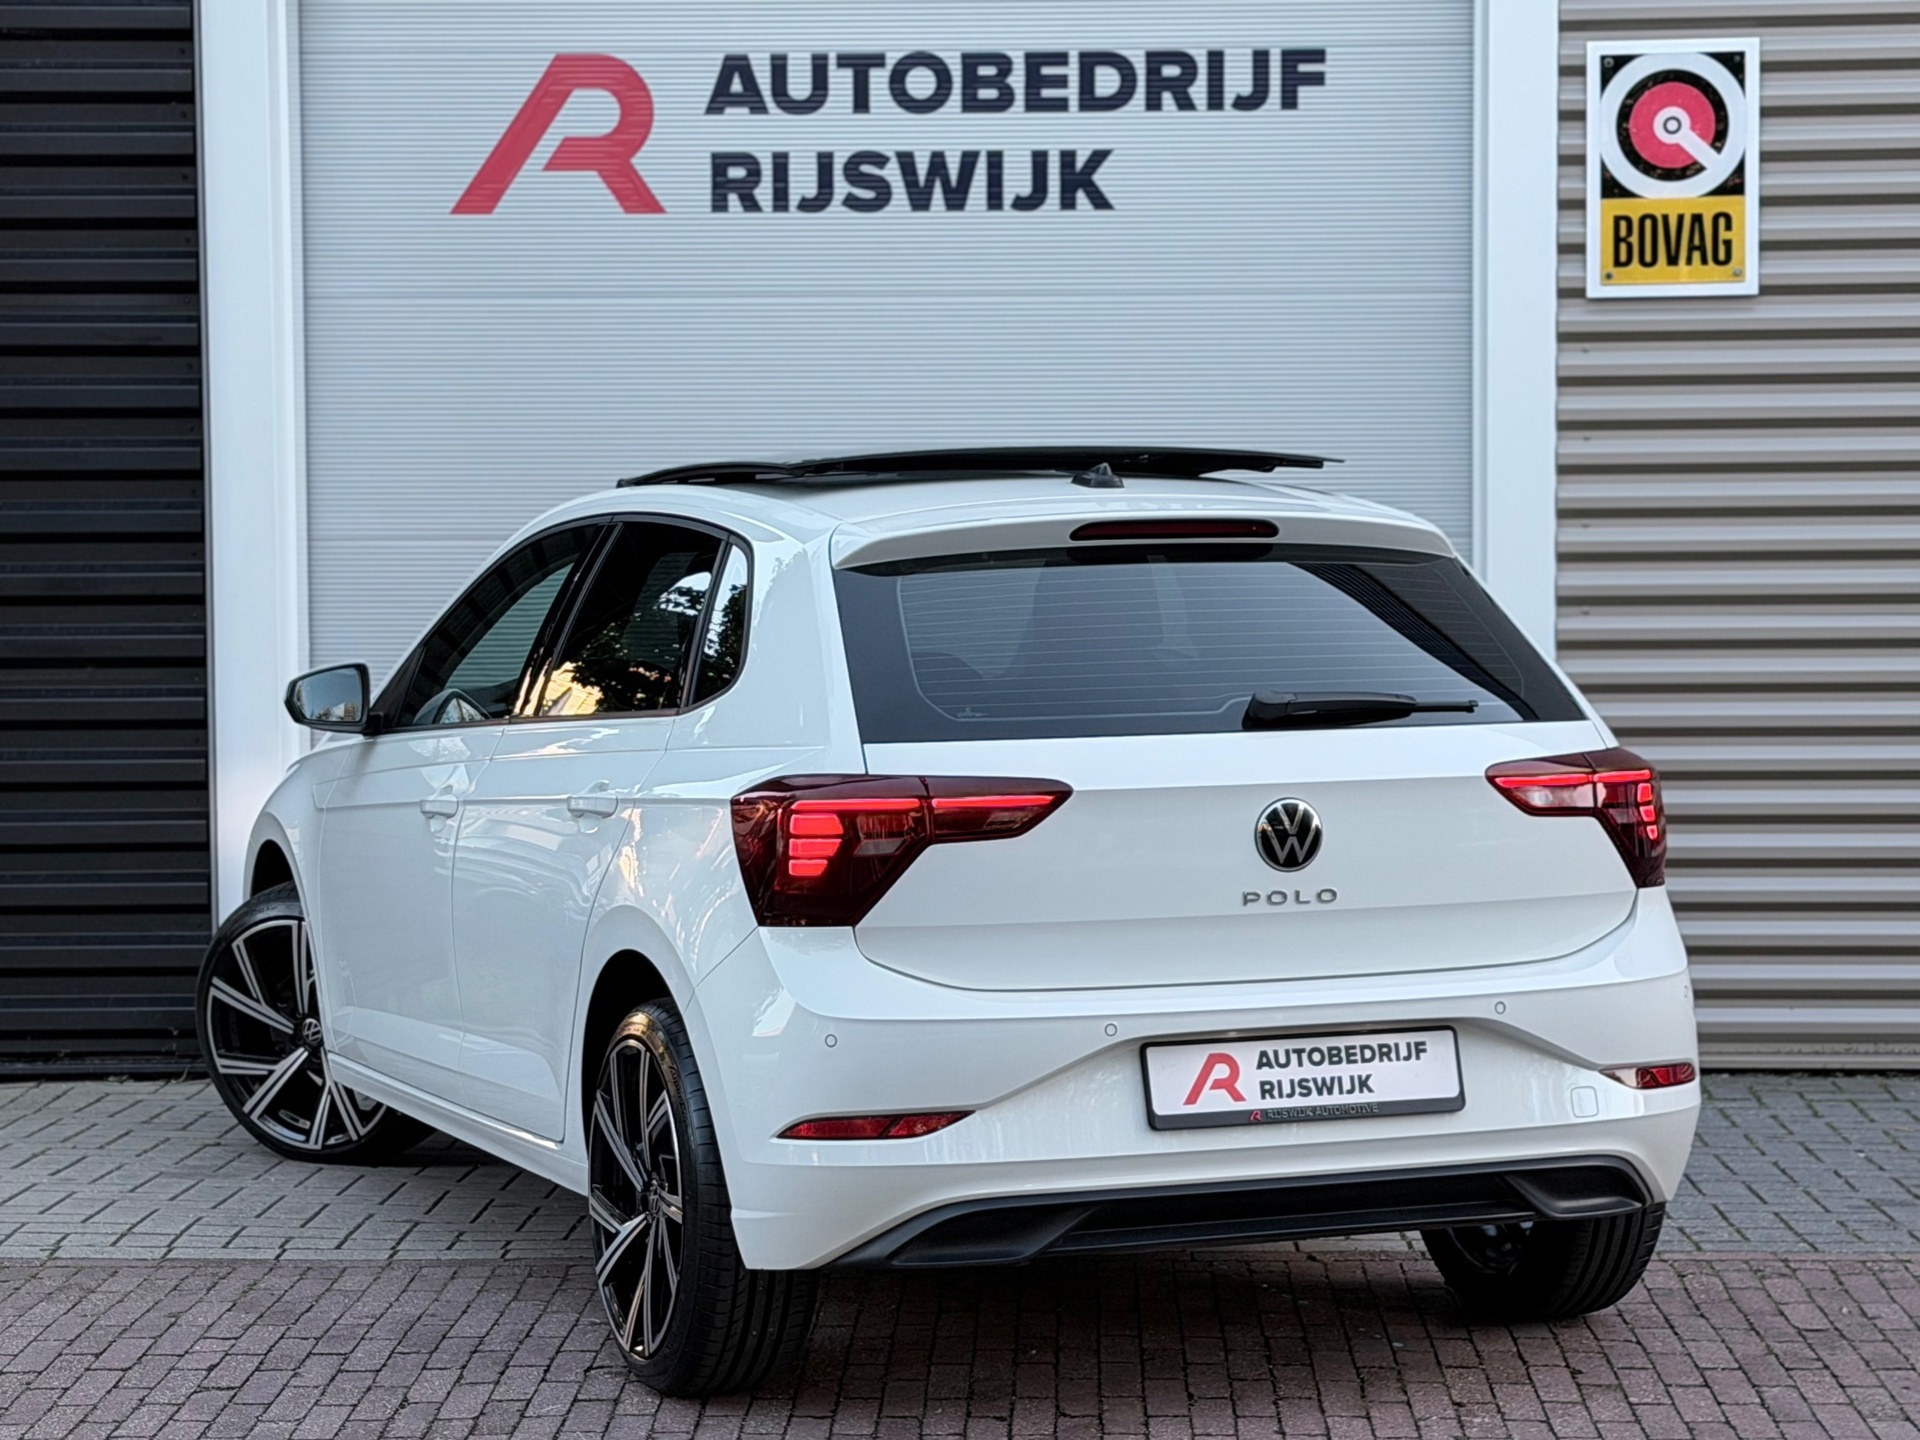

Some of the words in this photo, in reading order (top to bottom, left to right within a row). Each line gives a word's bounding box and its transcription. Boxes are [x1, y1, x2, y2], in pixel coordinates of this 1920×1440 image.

[705, 49, 1327, 116] AUTOBEDRIJF
[711, 149, 1114, 213] RIJSWIJK
[1612, 211, 1734, 269] BOVAG
[1242, 888, 1338, 906] POLO
[1256, 1041, 1428, 1070] AUTOBEDRIJF
[1259, 1074, 1375, 1100] RIJSWIJK
[1266, 1106, 1314, 1119] RIJSWIJK
[1315, 1102, 1380, 1116] AUTOMOTIVE
